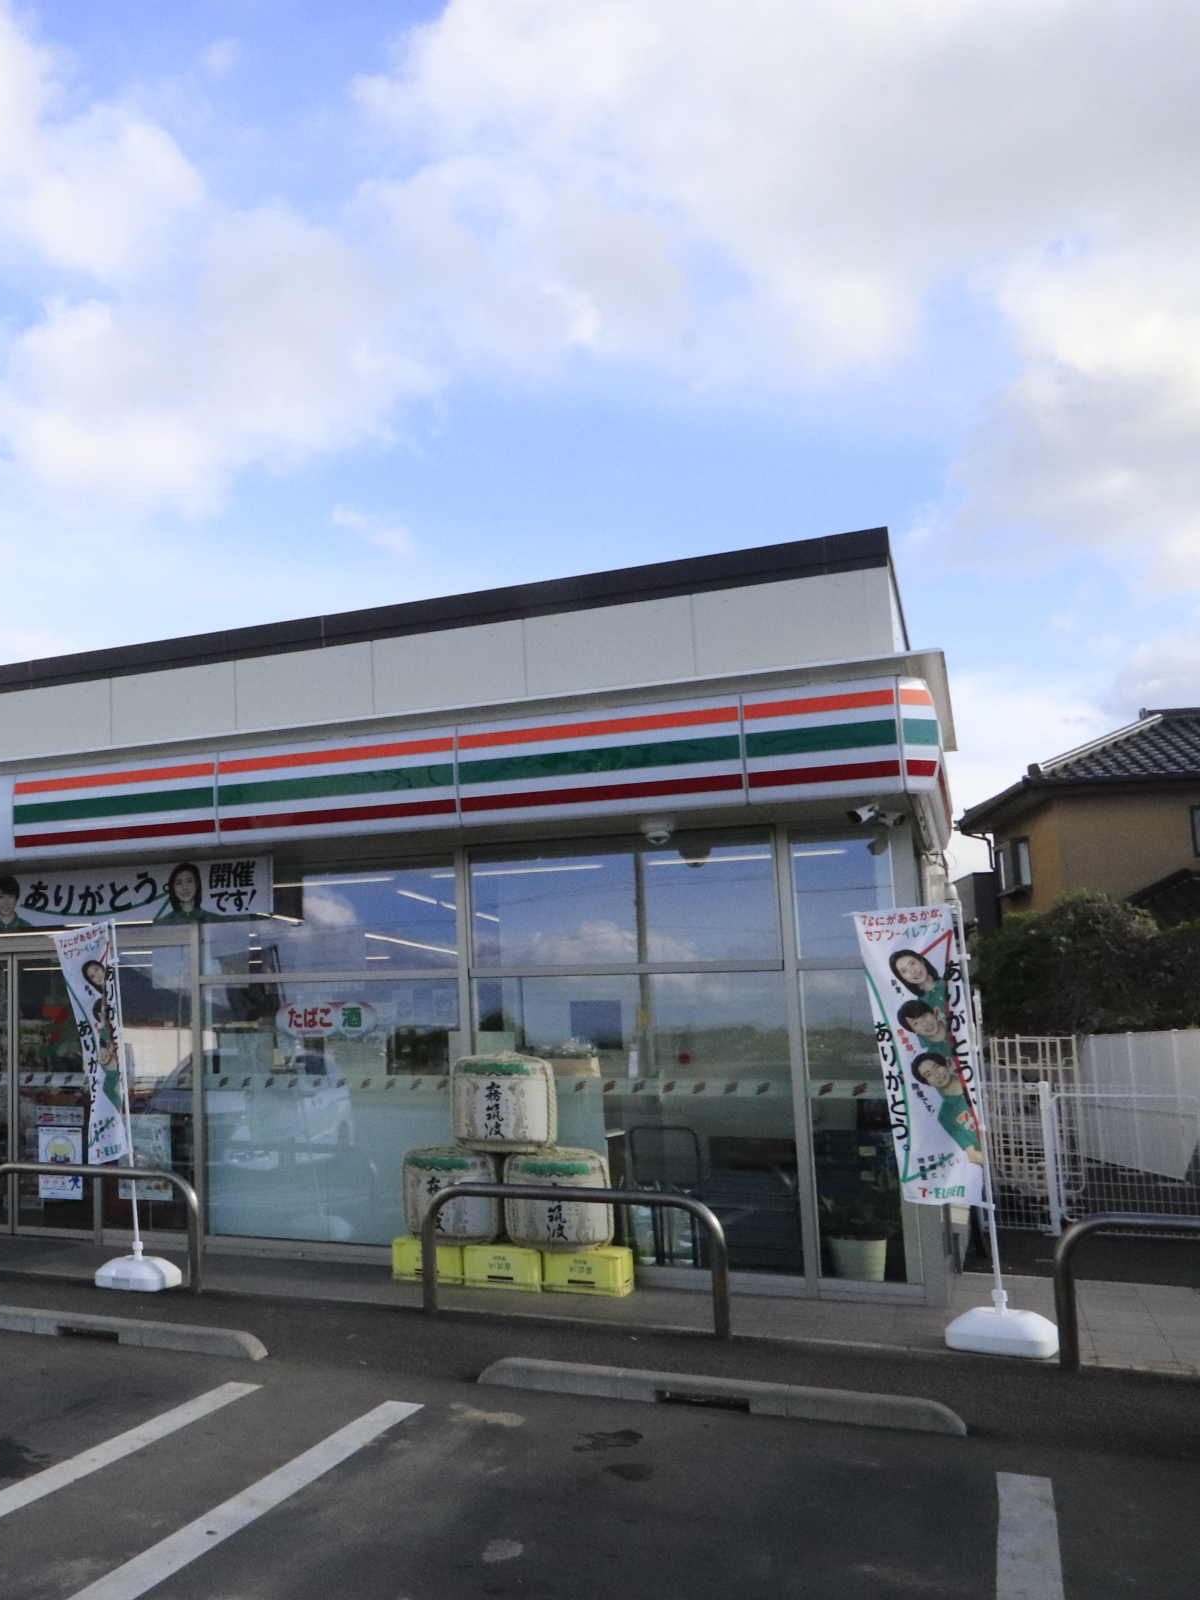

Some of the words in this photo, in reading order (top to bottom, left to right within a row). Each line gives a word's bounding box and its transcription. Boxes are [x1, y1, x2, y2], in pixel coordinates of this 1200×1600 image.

[208, 860, 257, 889] 開催
[210, 888, 257, 913] です!
[288, 1006, 333, 1028] たばこ
[341, 1007, 362, 1028] 酒
[874, 1021, 910, 1152] ありがとう。
